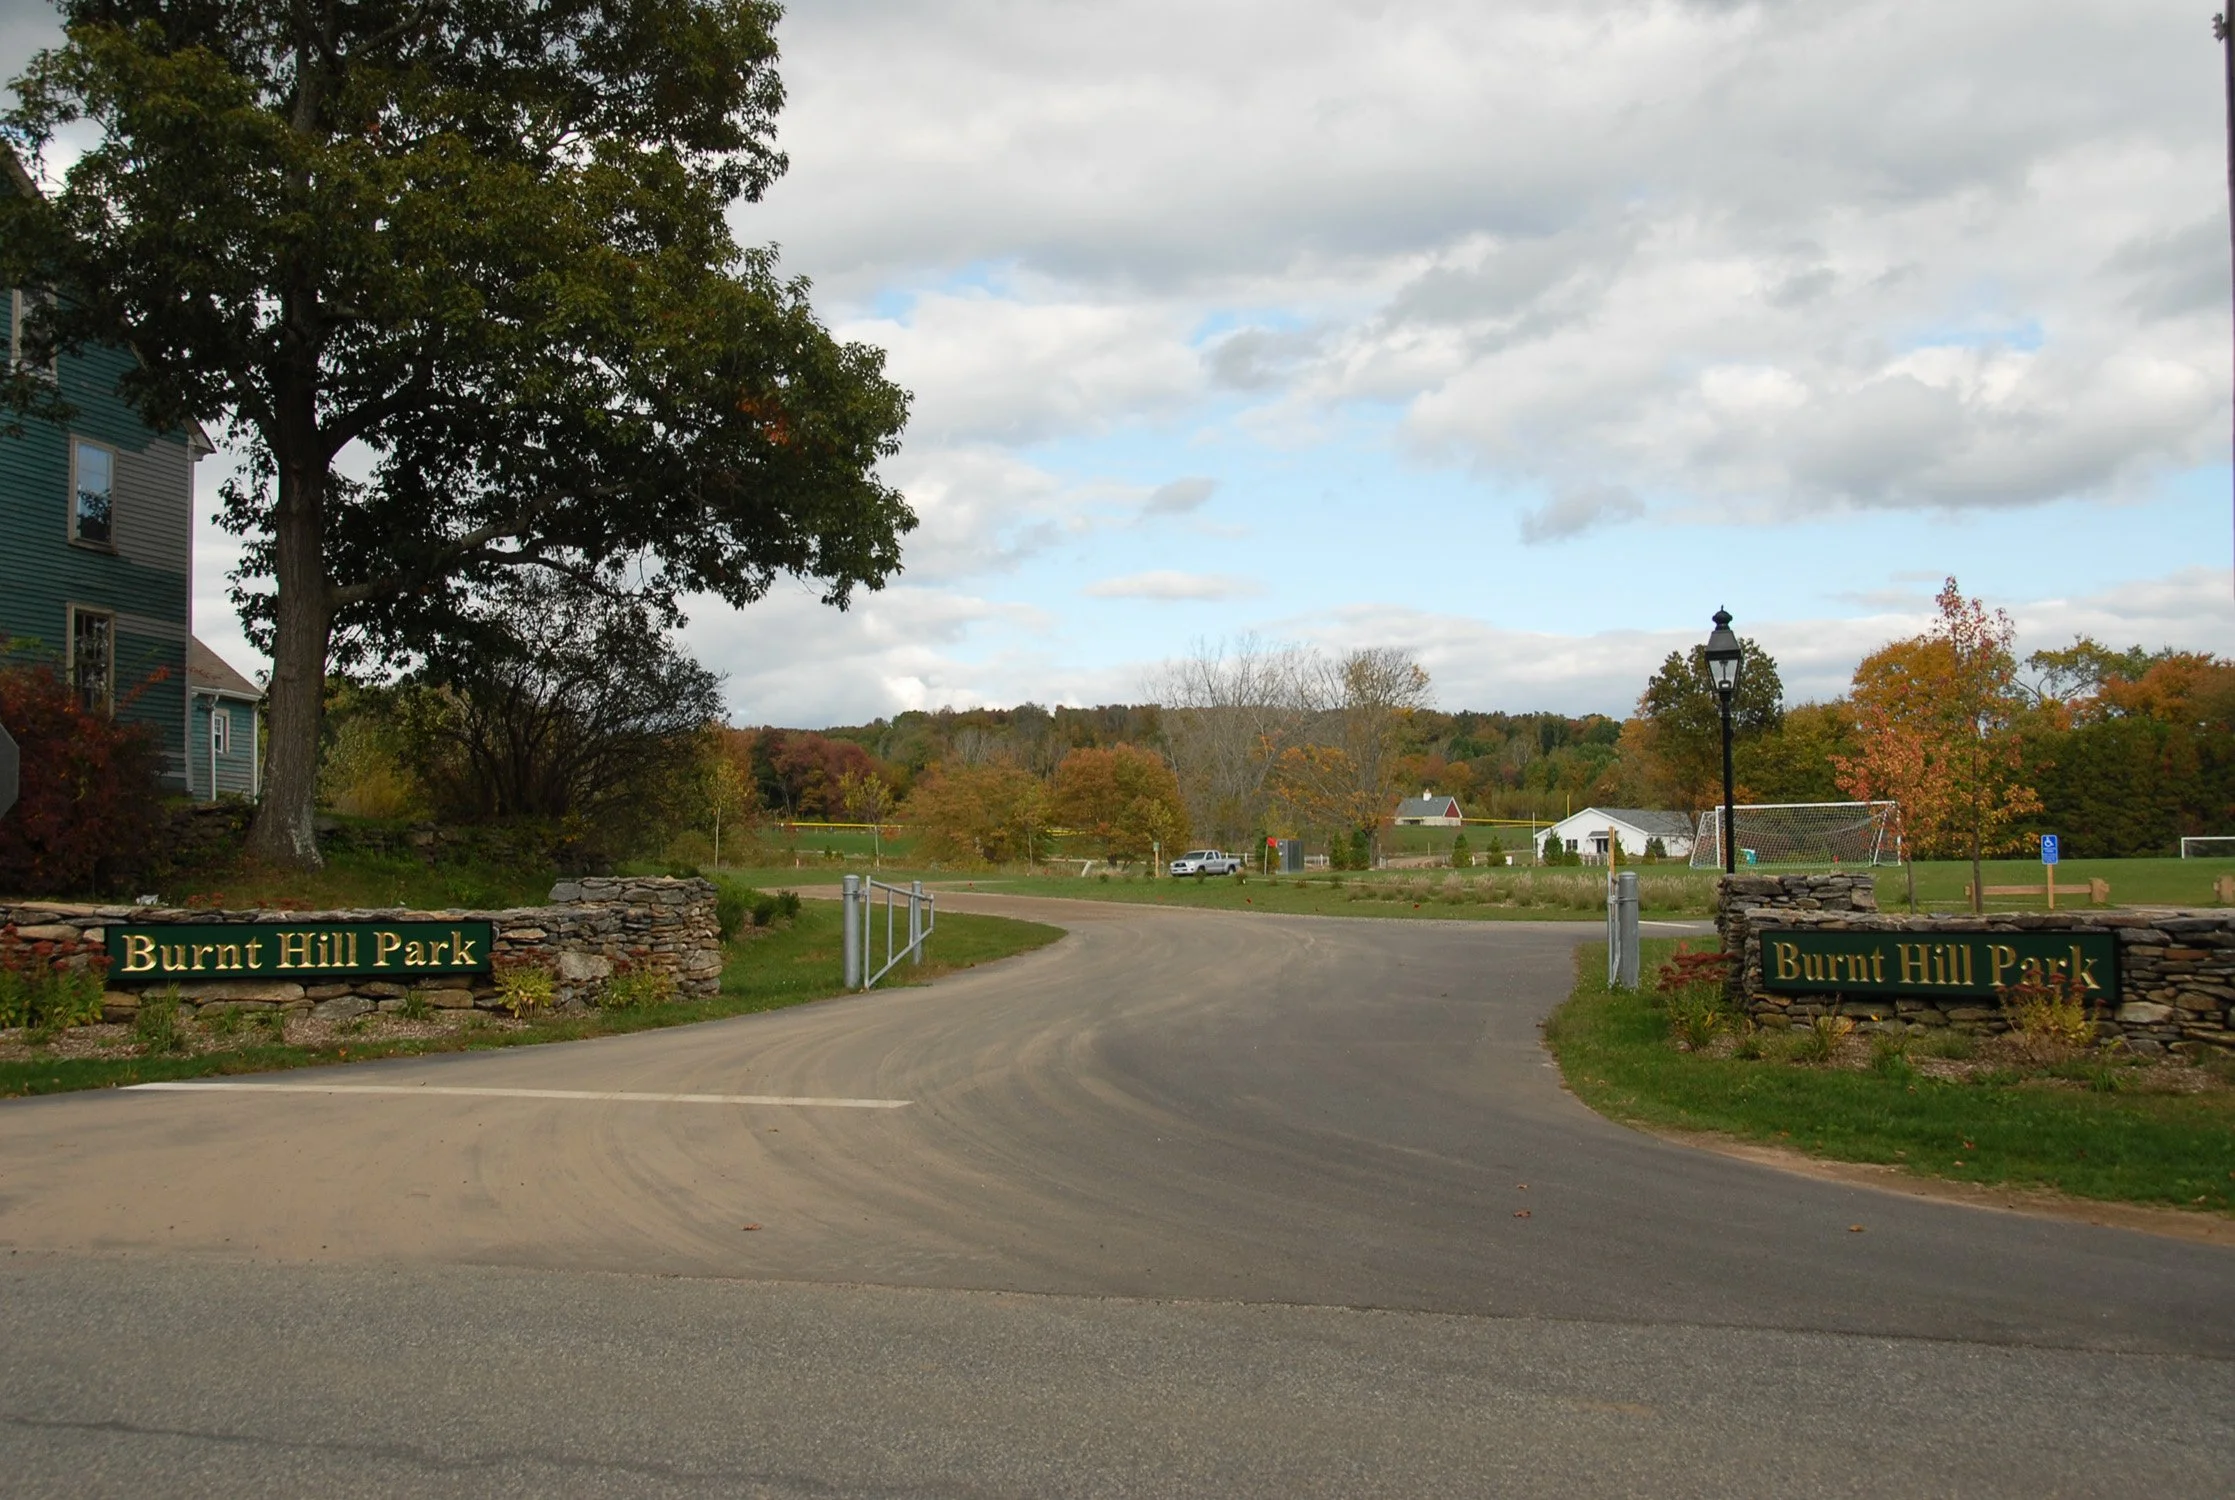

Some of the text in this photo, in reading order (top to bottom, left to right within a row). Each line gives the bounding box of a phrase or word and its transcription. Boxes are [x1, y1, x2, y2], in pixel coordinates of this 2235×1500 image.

[121, 930, 478, 973] Burnt Hill Park
[1773, 941, 2101, 990] Burnt Hill Park
